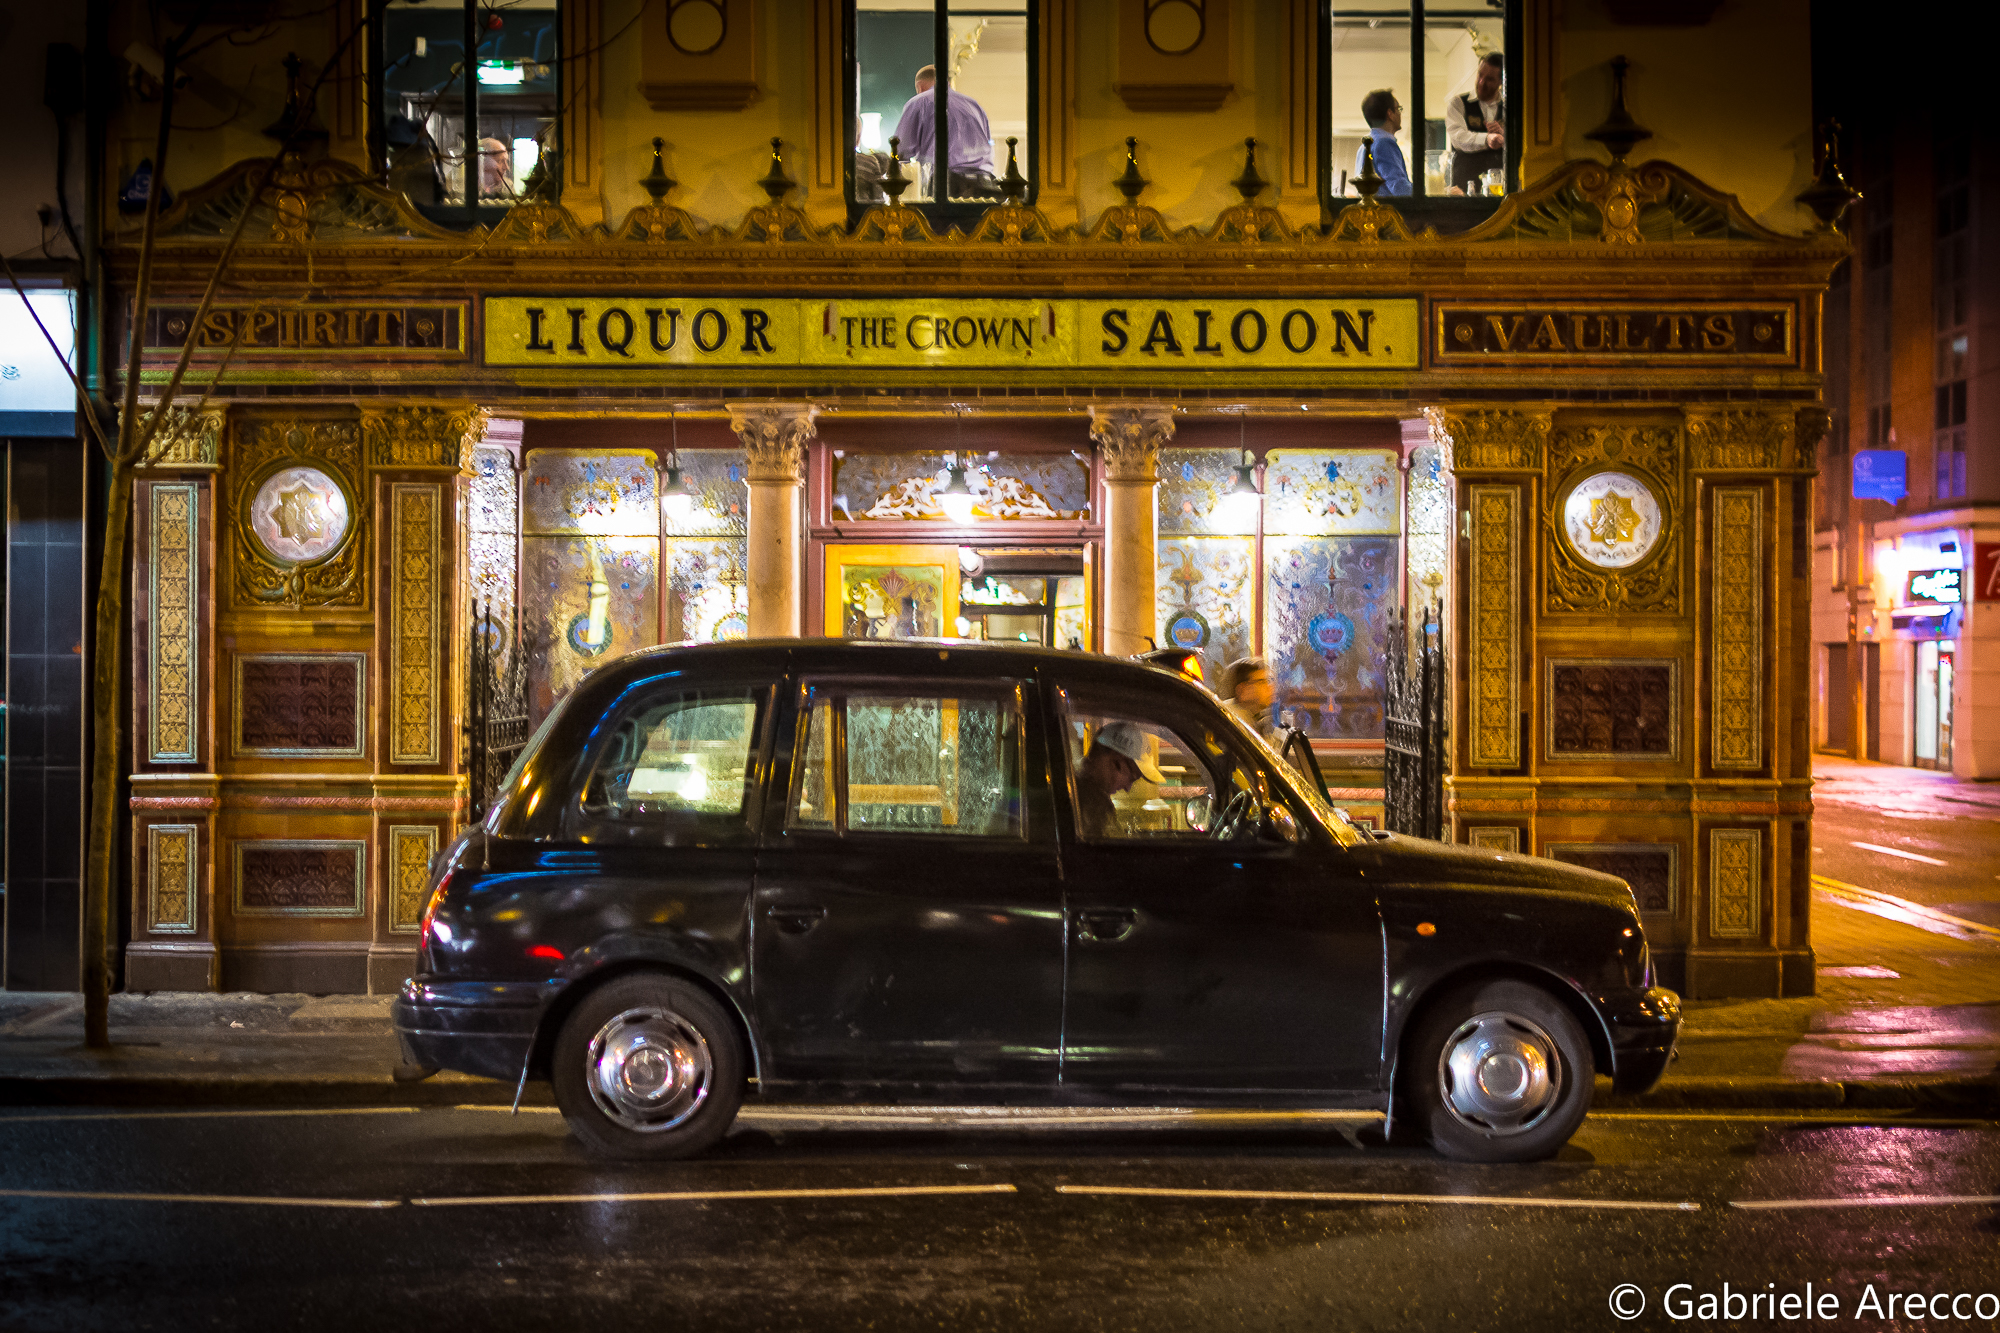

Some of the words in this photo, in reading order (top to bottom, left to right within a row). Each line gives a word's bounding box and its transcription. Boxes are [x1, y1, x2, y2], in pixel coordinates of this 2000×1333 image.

[202, 311, 403, 347] SPIRIT
[526, 307, 775, 356] LIQUOR
[842, 316, 897, 350] THE
[1101, 308, 1393, 355] SALOON.
[1486, 315, 1737, 351] VAULTS
